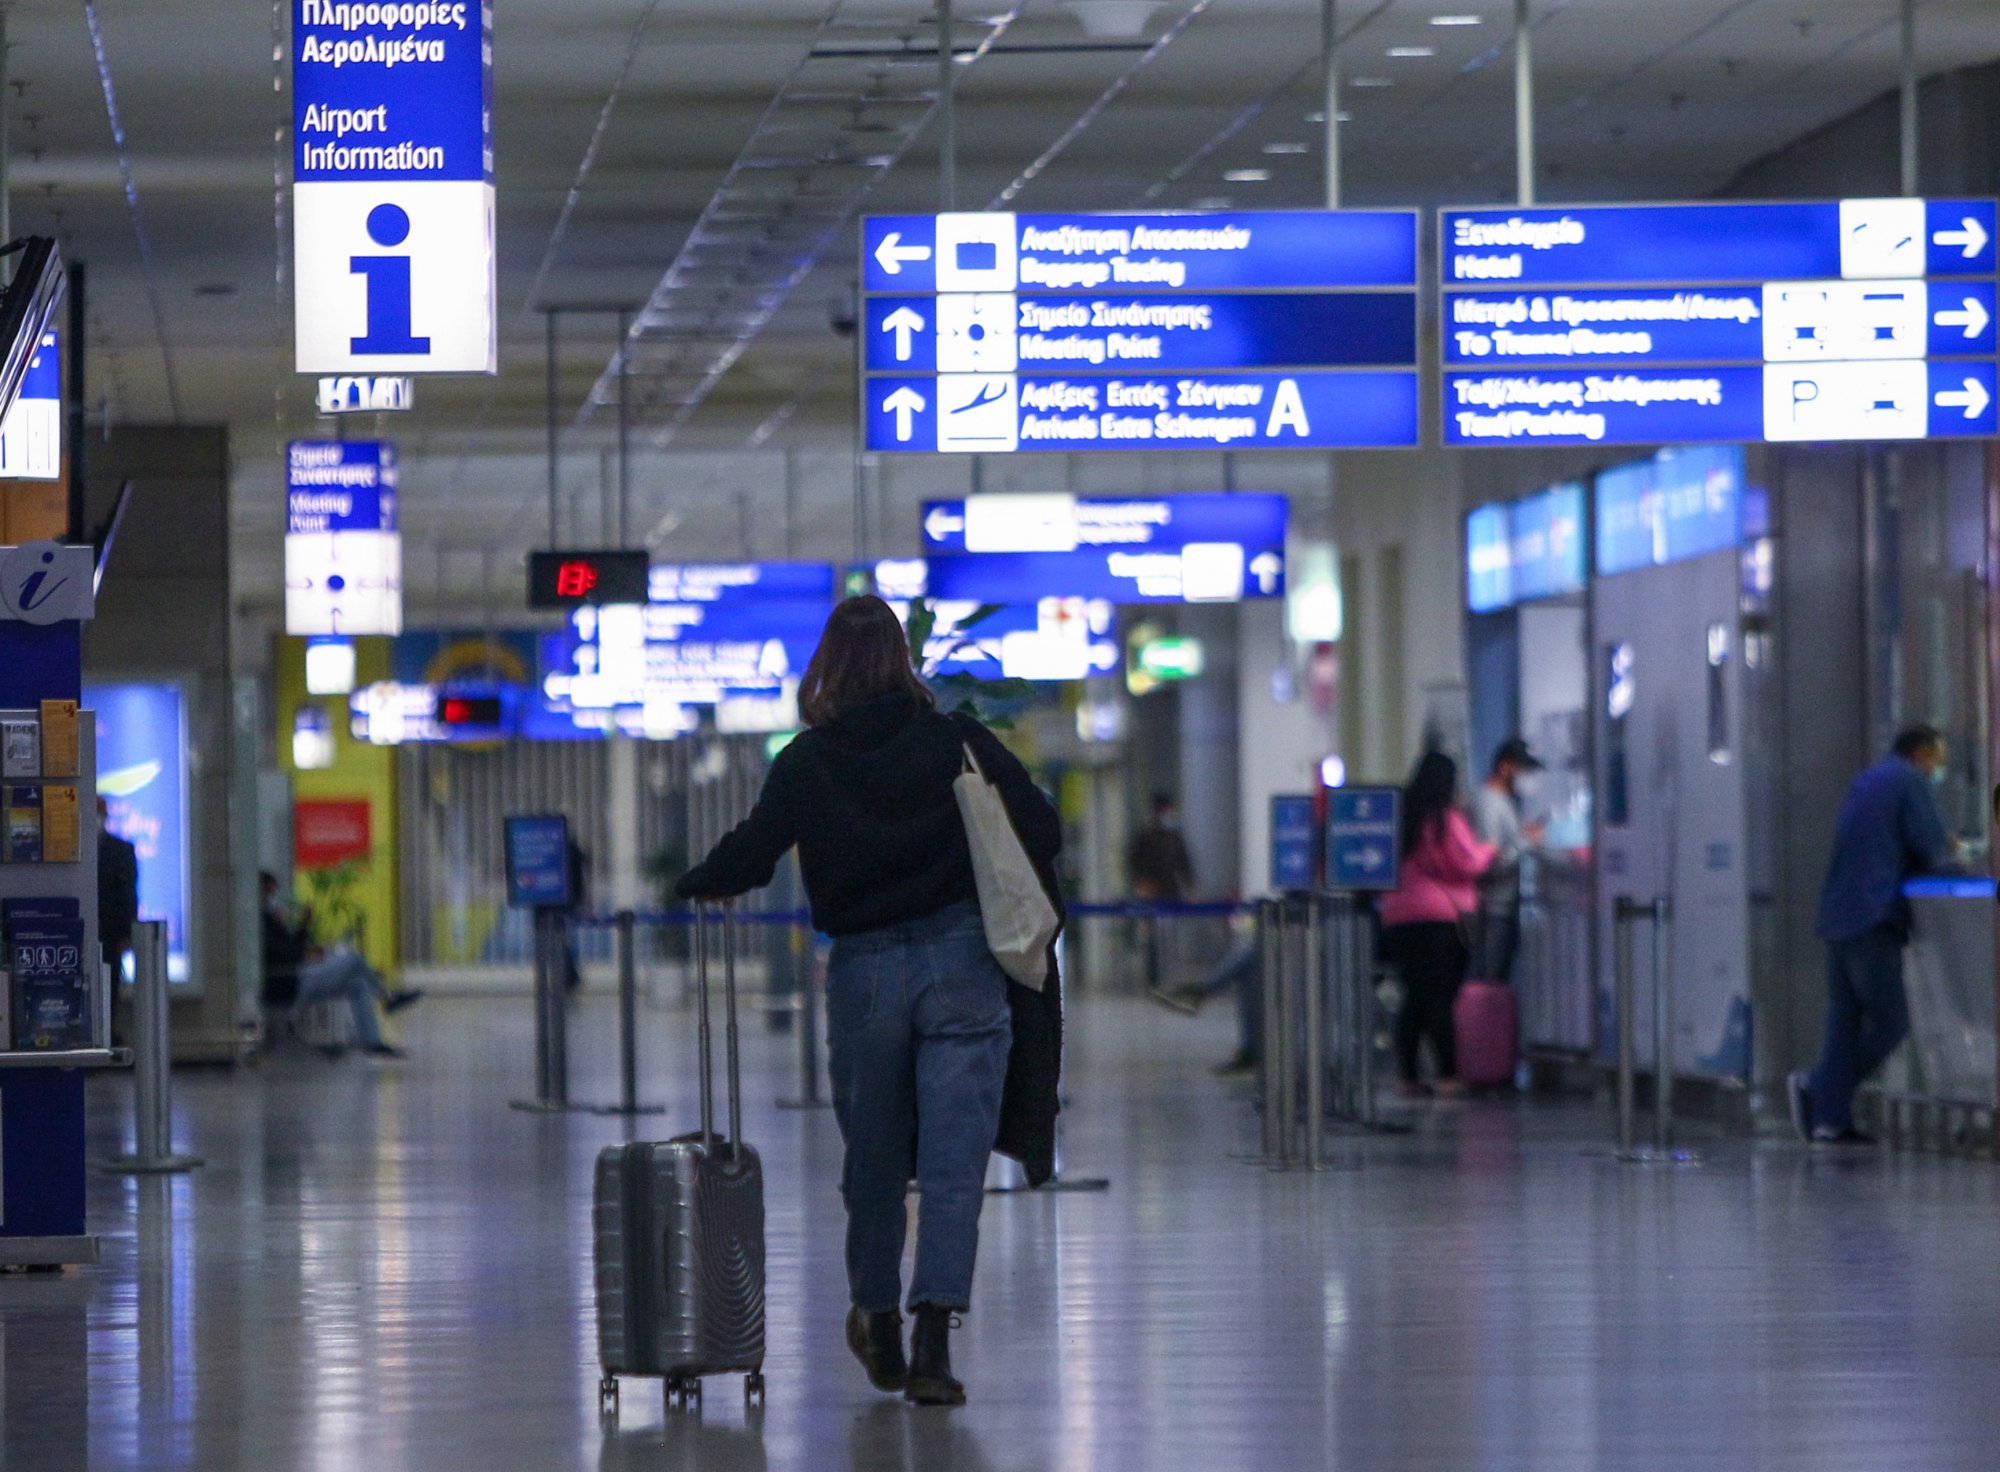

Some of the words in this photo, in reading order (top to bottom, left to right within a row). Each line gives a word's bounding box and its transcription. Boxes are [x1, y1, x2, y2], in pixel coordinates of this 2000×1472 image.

[303, 0, 465, 30] Πληροφορίες
[302, 35, 444, 67] Αερολιμένα
[303, 104, 386, 137] Airport
[304, 142, 443, 169] Information
[1021, 226, 1130, 255] Αναζήτηση
[1131, 226, 1250, 250] Αποσκευών
[350, 203, 431, 356] i
[1020, 302, 1089, 331] Σημείο
[1091, 302, 1211, 330] Συνάντησης
[1020, 334, 1104, 363] Meeting
[1107, 333, 1160, 358] Point
[1020, 382, 1098, 411] Αφίξεις
[1107, 382, 1168, 410] Εκτός
[1177, 381, 1263, 410] Σένγκεν
[1021, 415, 1098, 439] Arrivals
[1101, 413, 1153, 438] Extra
[1154, 413, 1255, 442] Schengen
